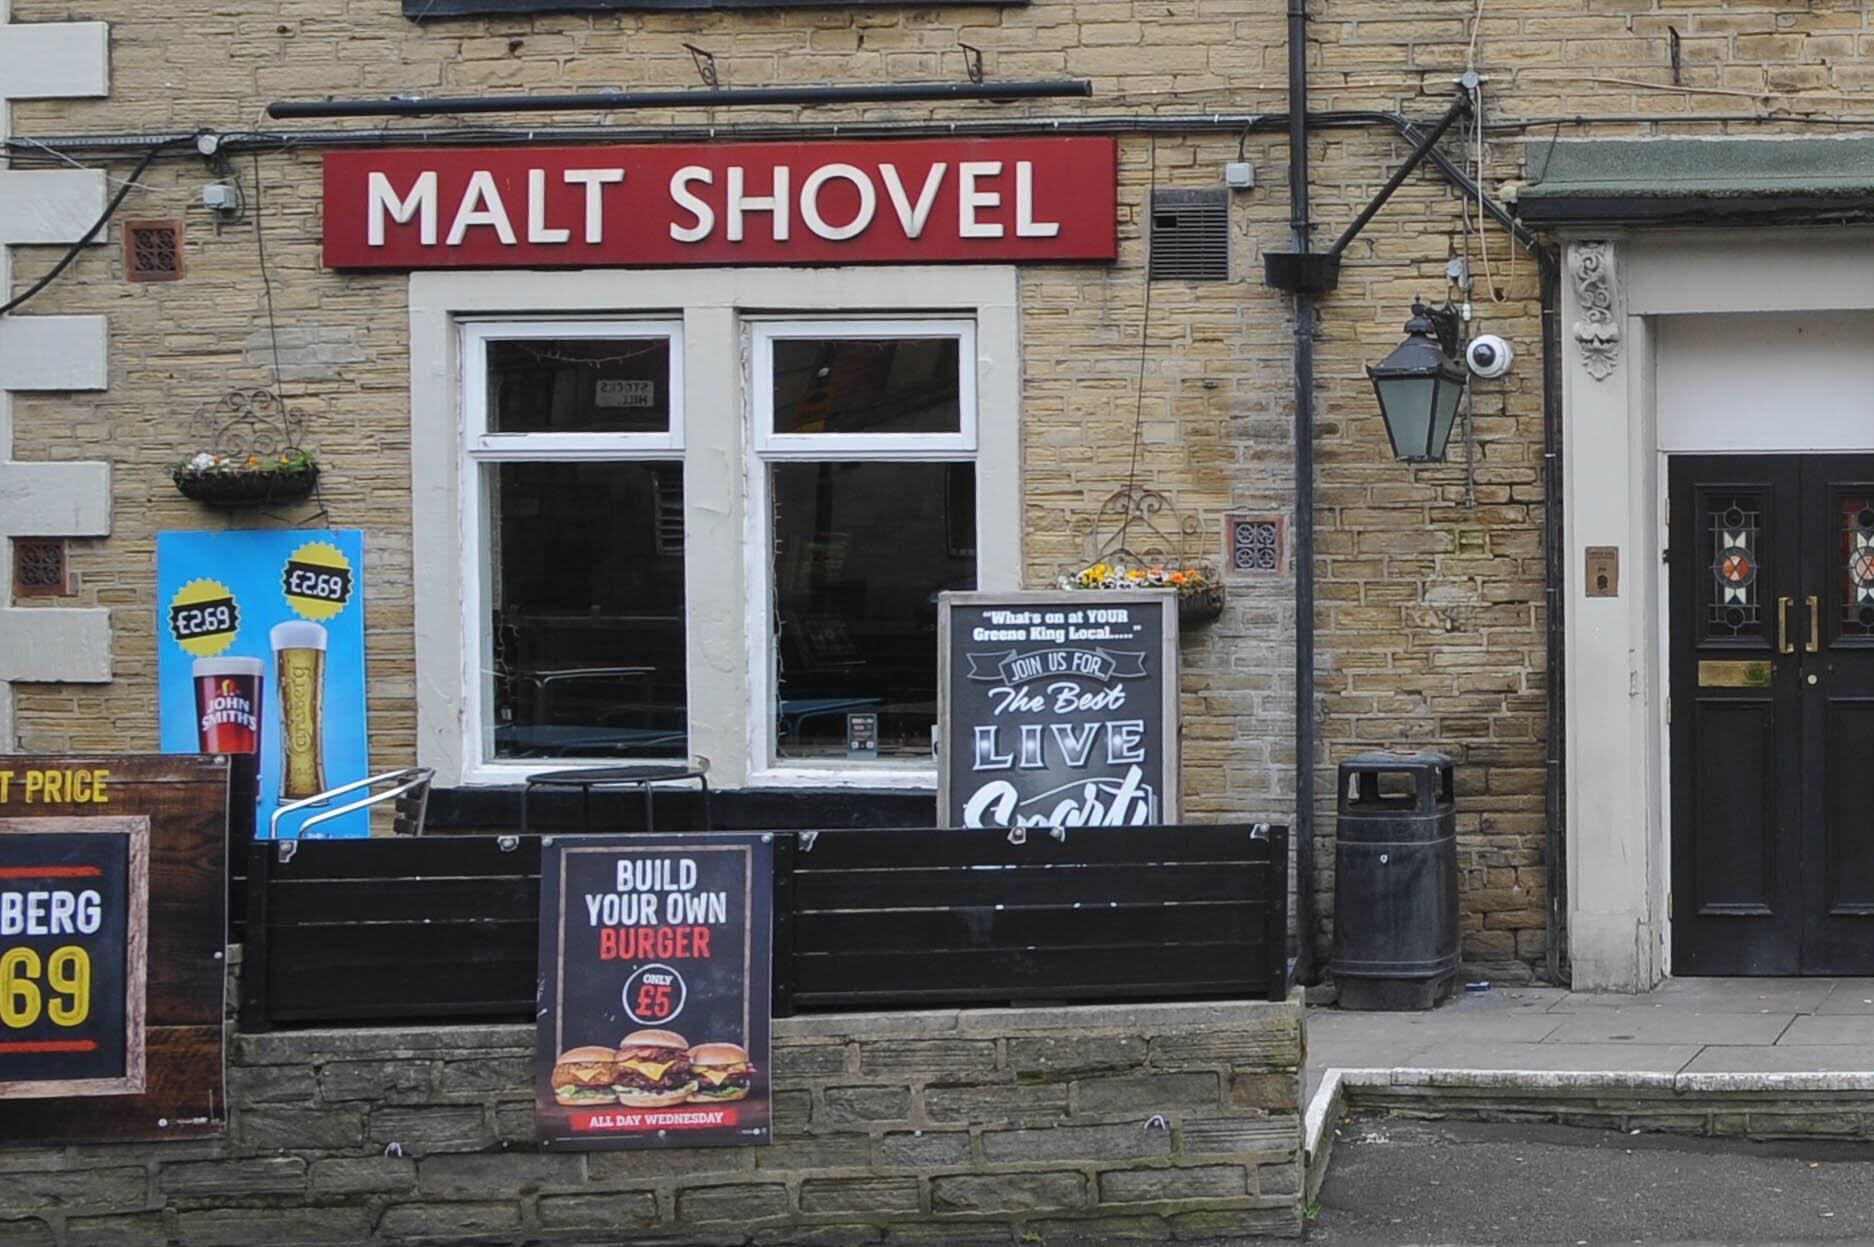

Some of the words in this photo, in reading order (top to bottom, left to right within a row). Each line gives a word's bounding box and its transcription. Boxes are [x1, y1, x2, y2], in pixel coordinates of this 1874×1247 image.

[367, 167, 627, 247] MALT
[669, 161, 1061, 244] SHOVEL
[289, 570, 342, 599] £2.69
[175, 606, 230, 635] £2.69
[1045, 613, 1064, 624] on
[1068, 611, 1083, 623] at
[1087, 609, 1128, 623] YOUR
[973, 627, 1026, 641] Greene
[1030, 626, 1065, 643] King
[1012, 656, 1043, 681] JOIN
[1048, 652, 1067, 671] US
[207, 696, 250, 714] JOHN
[988, 685, 1045, 716] The
[1047, 682, 1126, 714] Best
[972, 720, 1145, 771] LIVE
[25, 769, 110, 803] PRICE
[616, 858, 697, 892] BUILD
[0, 890, 102, 936] BERG
[585, 893, 658, 926] YOUR
[666, 892, 727, 925] OWN
[599, 927, 711, 960] BURGER
[643, 975, 673, 985] ONLY
[635, 986, 672, 1017] £5
[590, 1116, 613, 1128] ALL
[616, 1114, 641, 1127] DAY
[644, 1112, 724, 1126] WEDNESDAY
